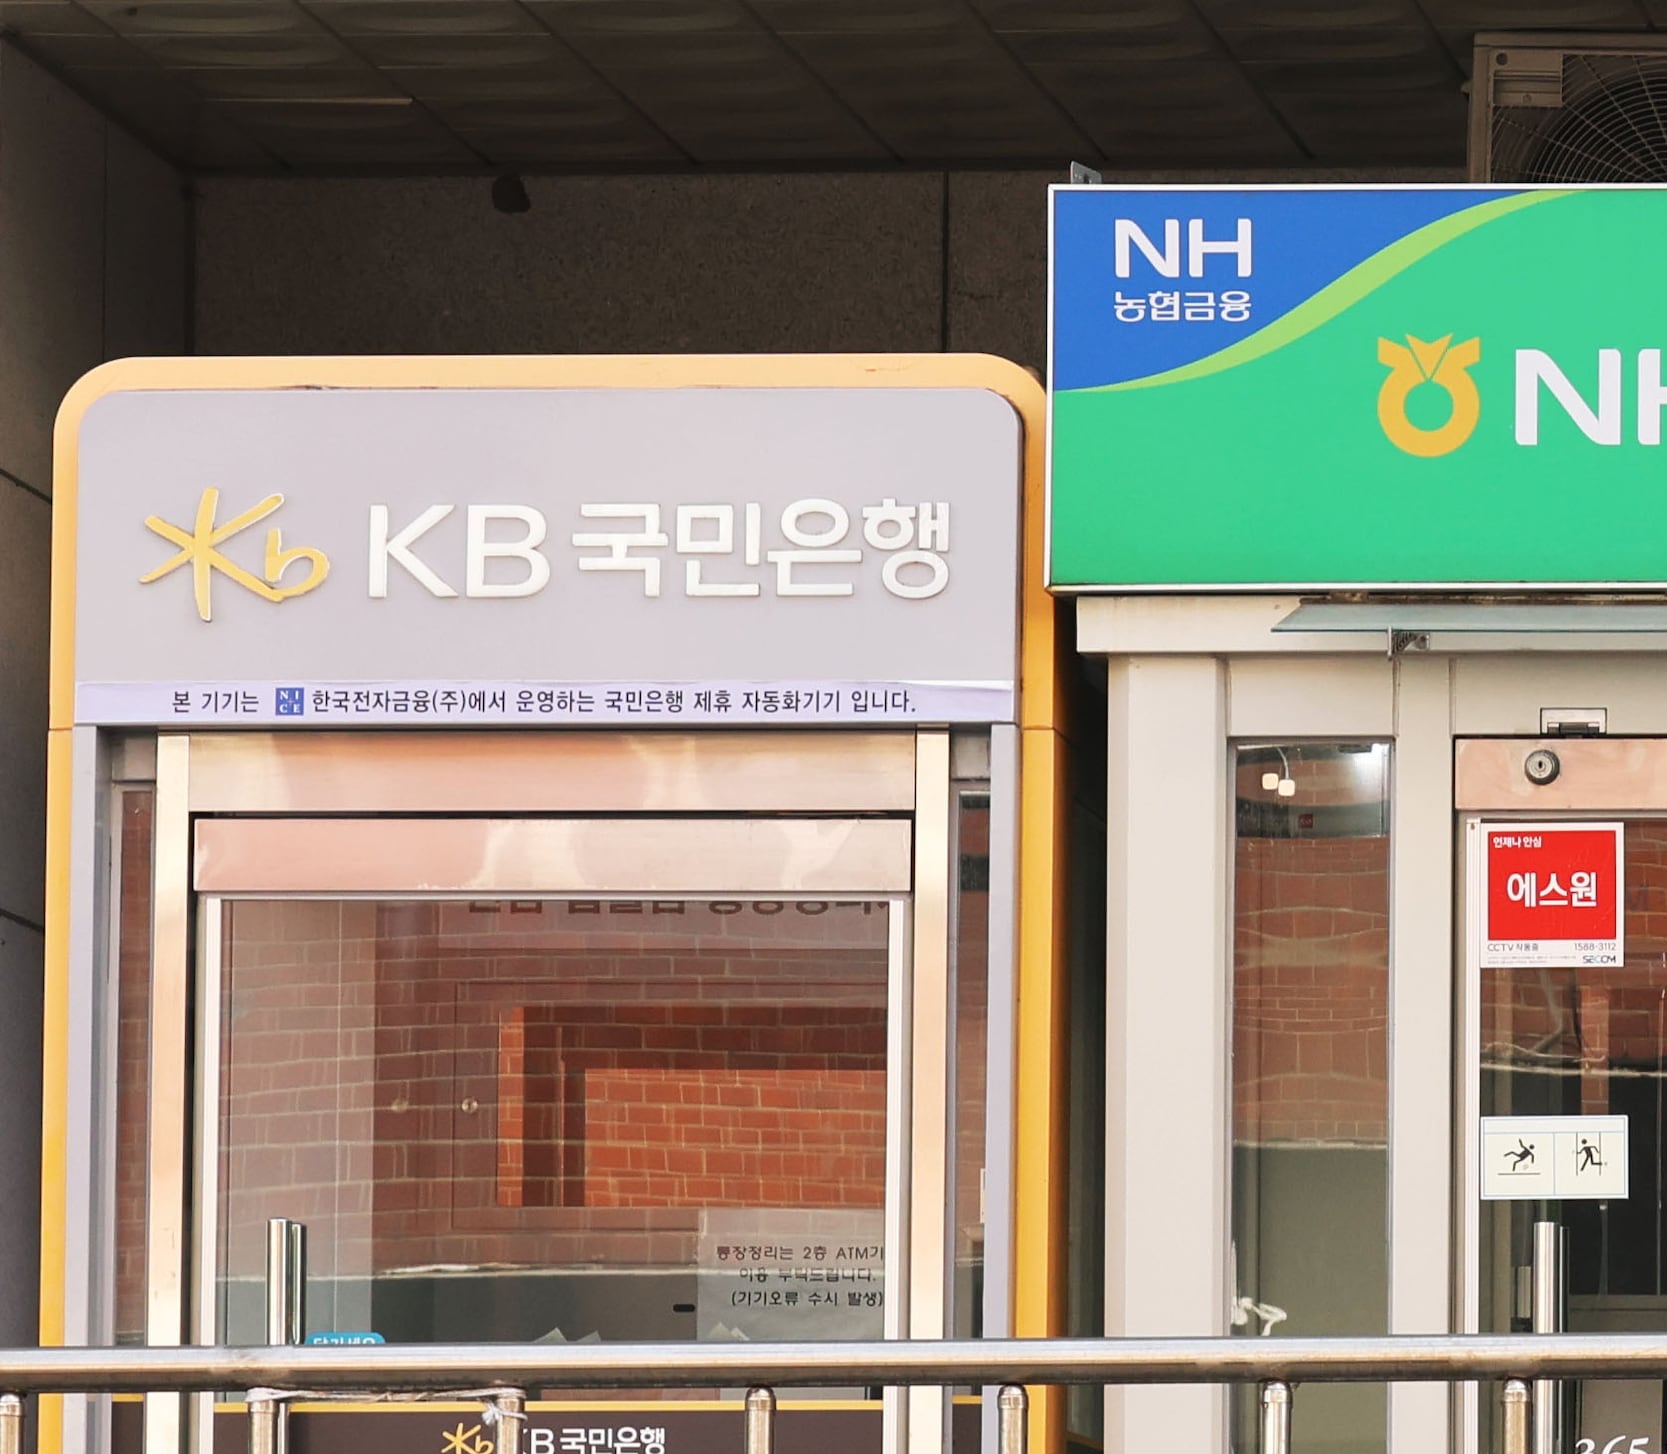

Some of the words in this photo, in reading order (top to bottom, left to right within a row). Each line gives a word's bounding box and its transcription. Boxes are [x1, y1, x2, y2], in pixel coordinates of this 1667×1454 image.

[1113, 218, 1253, 278] NH
[1112, 290, 1253, 323] 농협금융
[368, 503, 550, 600] KB
[570, 497, 951, 600] 국민은행
[172, 691, 191, 713] 본
[201, 690, 260, 713] 기기는
[312, 689, 507, 714] 한국전자금융(주)에서
[516, 690, 595, 713] 운영하는
[604, 690, 683, 713] 국민은행
[694, 690, 732, 713] 제휴
[741, 690, 841, 713] 자동화기기
[851, 690, 917, 713] 입니다.
[1493, 836, 1521, 849] 언제나
[1523, 836, 1542, 848] 안심
[1507, 872, 1597, 908] 에스원
[1487, 943, 1514, 952] CCTV
[1574, 943, 1617, 951] 1588-3112
[717, 1246, 793, 1260] 통장정리는
[803, 1246, 827, 1260] 2층
[731, 1291, 799, 1307] (기기오류
[808, 1292, 838, 1306] 수시
[848, 1291, 883, 1307] 발생)
